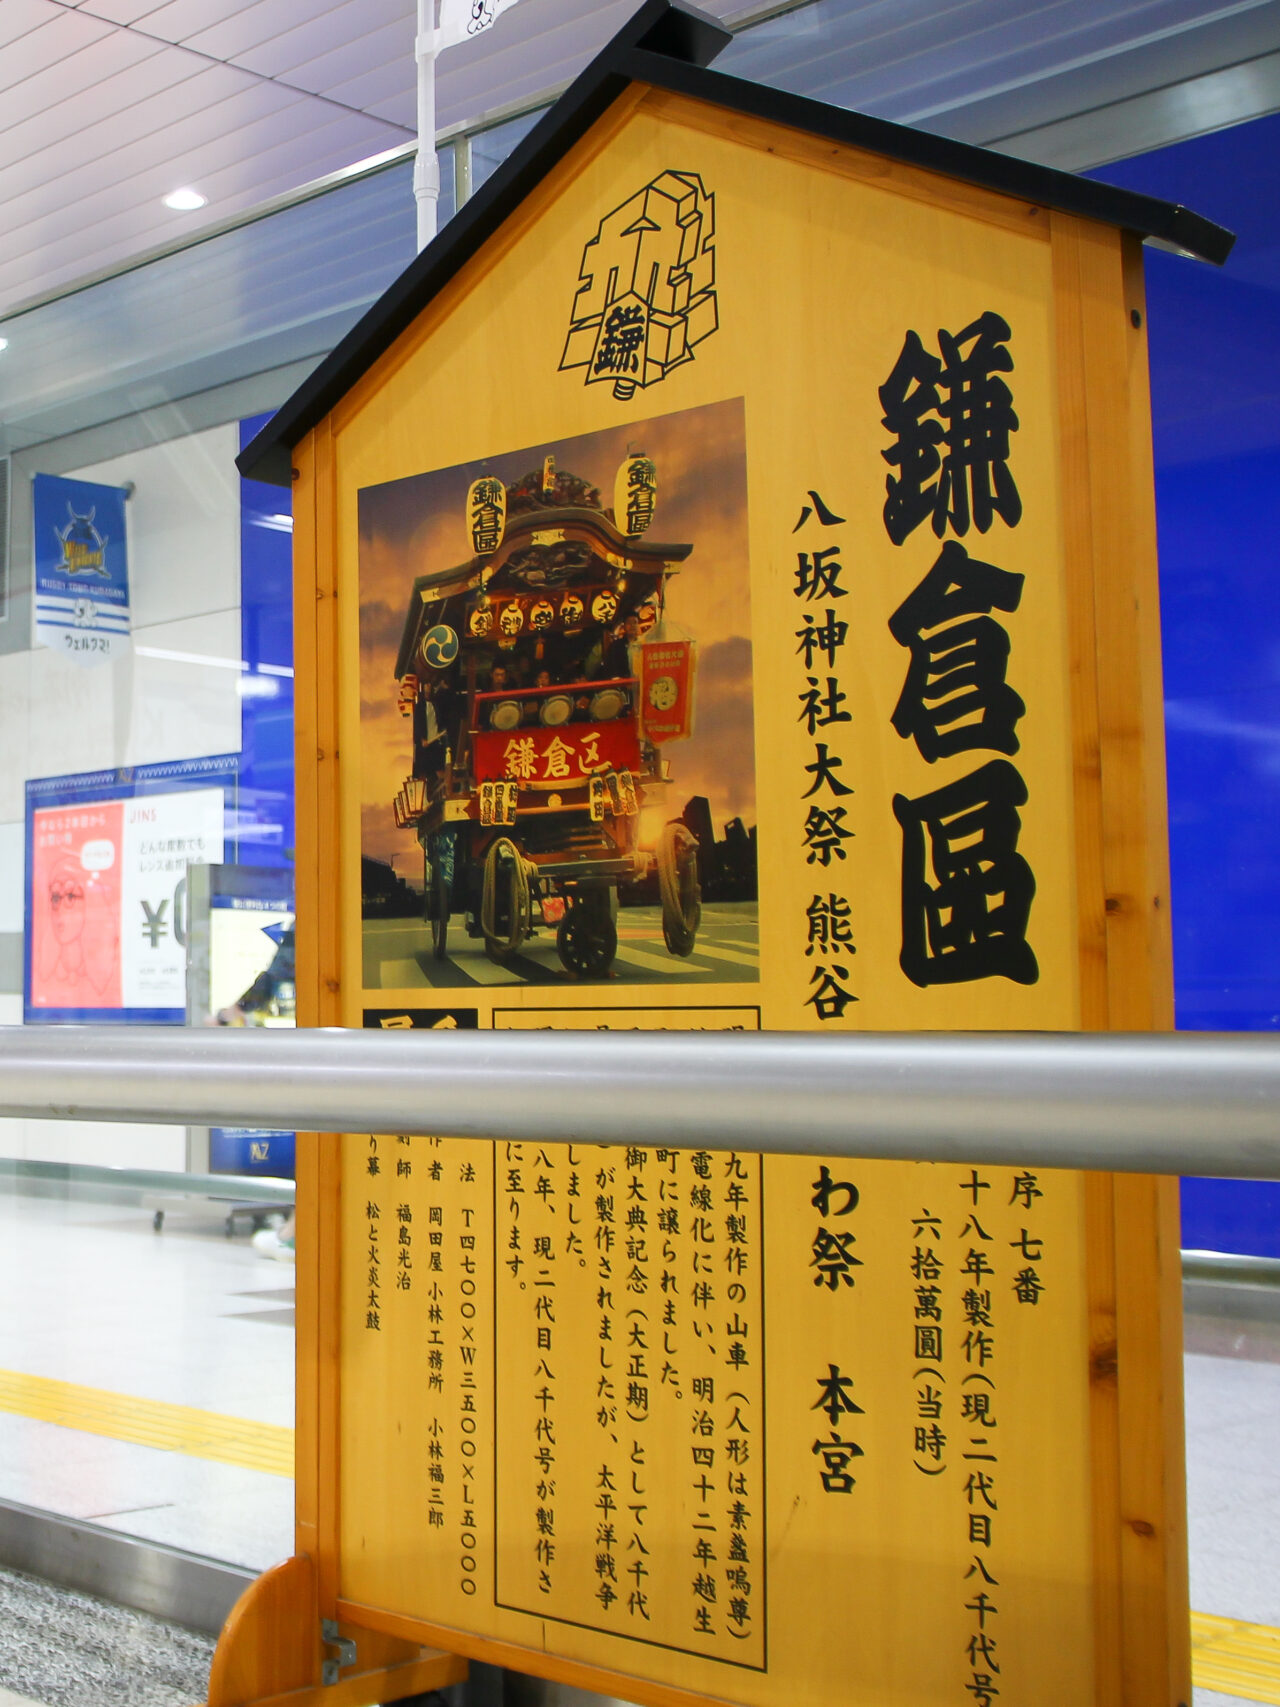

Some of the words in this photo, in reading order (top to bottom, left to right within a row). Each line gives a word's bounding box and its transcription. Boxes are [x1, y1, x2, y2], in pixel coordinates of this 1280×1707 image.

[792, 491, 856, 867] 八坂神社大祭
[130, 808, 157, 824] JINS
[503, 732, 613, 779] 鎌倉区
[803, 893, 860, 1020] 熊谷
[365, 1200, 382, 1332] 松と火炎太鼓
[396, 1203, 413, 1291] 福島光治
[1009, 1228, 1046, 1306] 七番
[594, 1145, 618, 1611] が製作されましたが、太平洋戦争
[810, 1363, 865, 1494] 本宮
